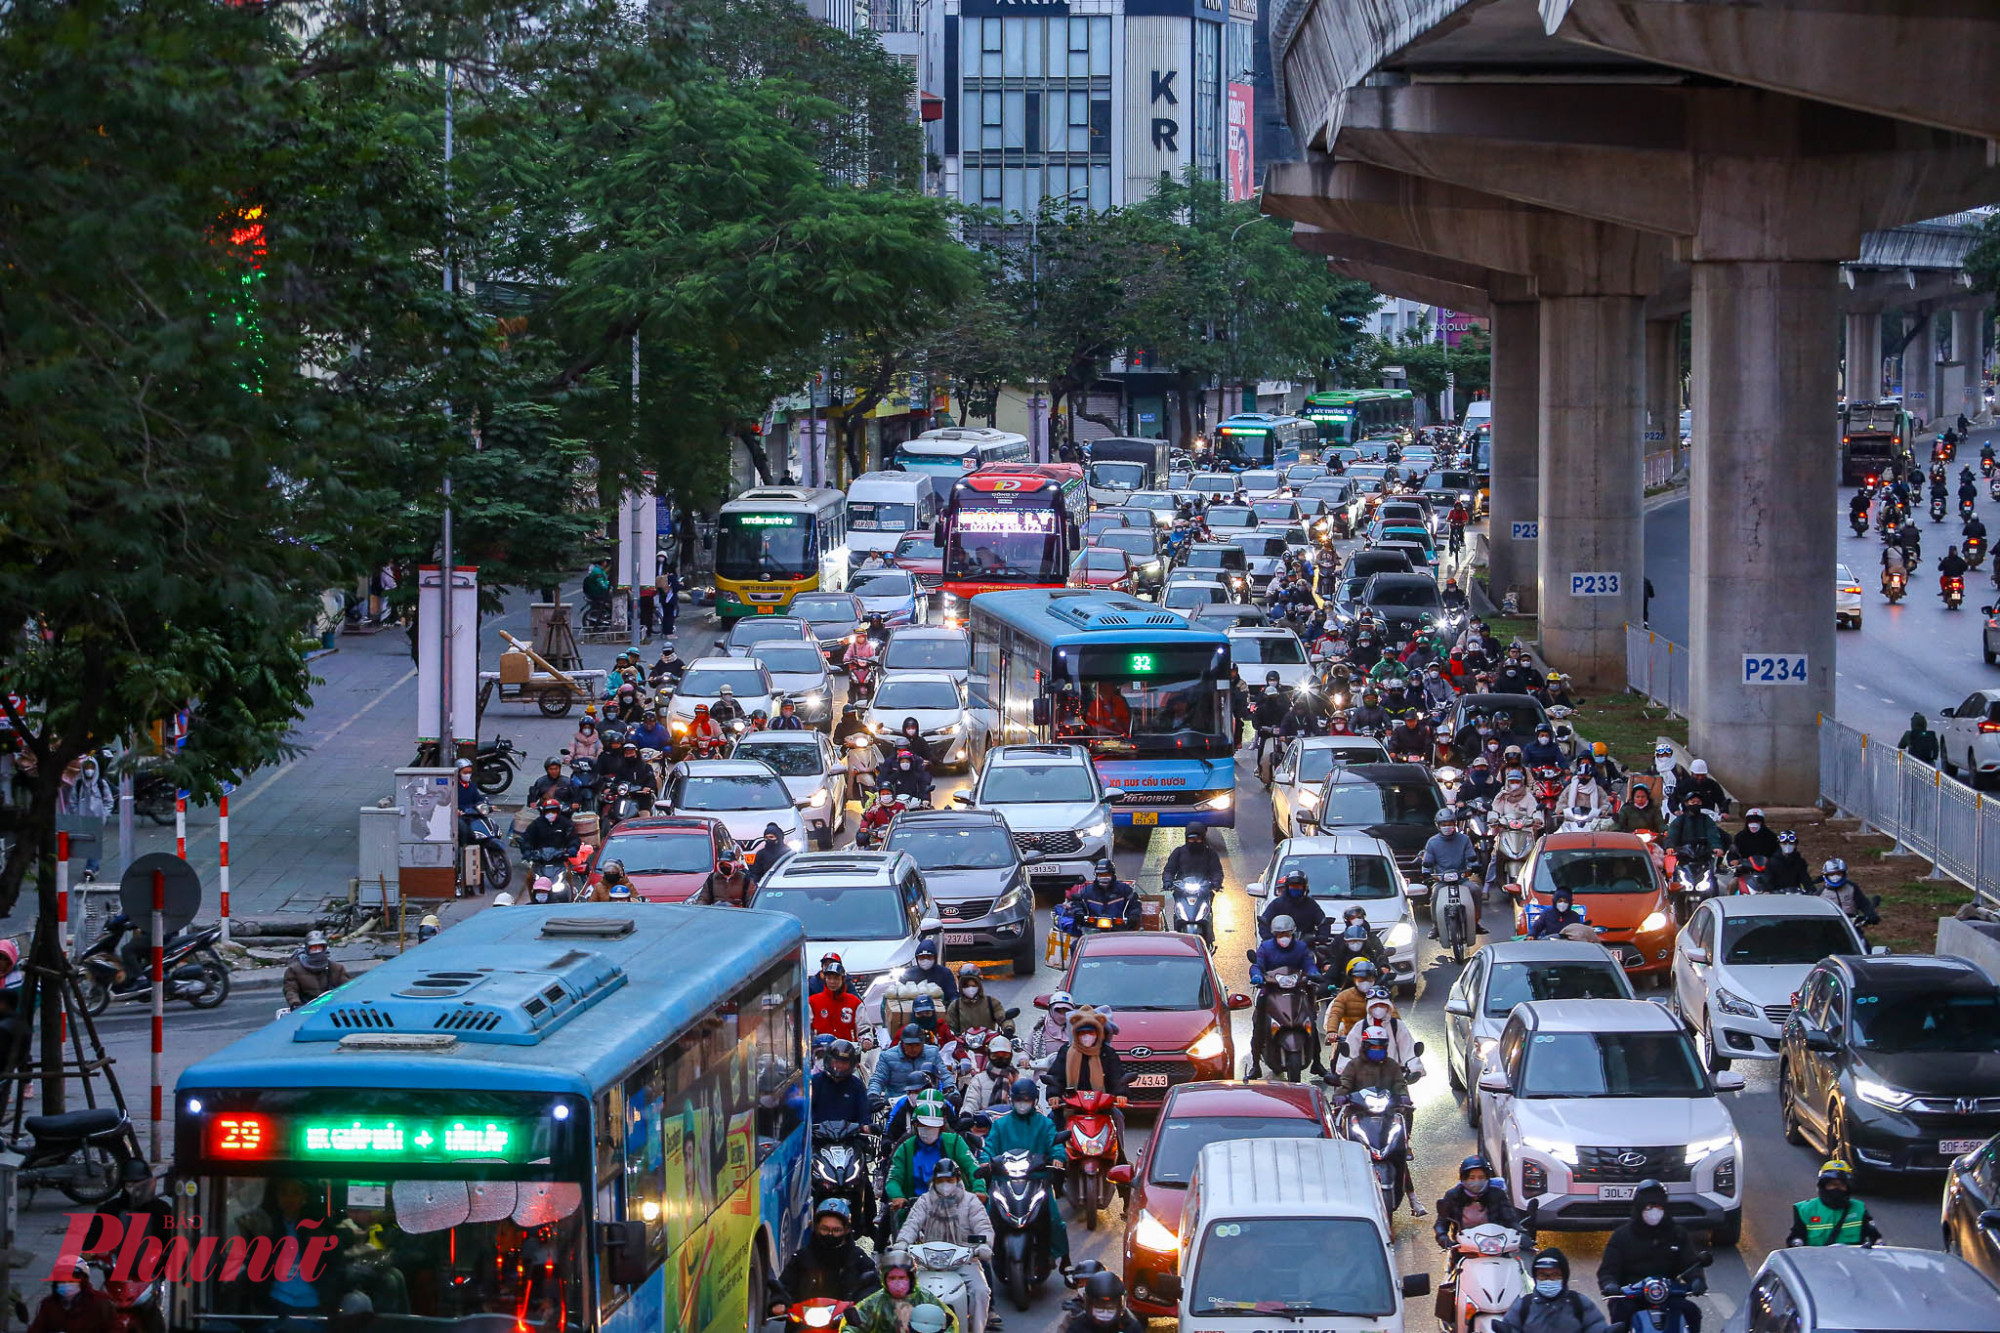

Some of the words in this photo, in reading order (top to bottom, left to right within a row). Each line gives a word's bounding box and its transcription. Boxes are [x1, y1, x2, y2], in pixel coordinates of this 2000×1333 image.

[1513, 524, 1538, 538] P23
[1573, 576, 1619, 593] P233
[1133, 656, 1151, 670] 32
[1746, 658, 1807, 681] P234
